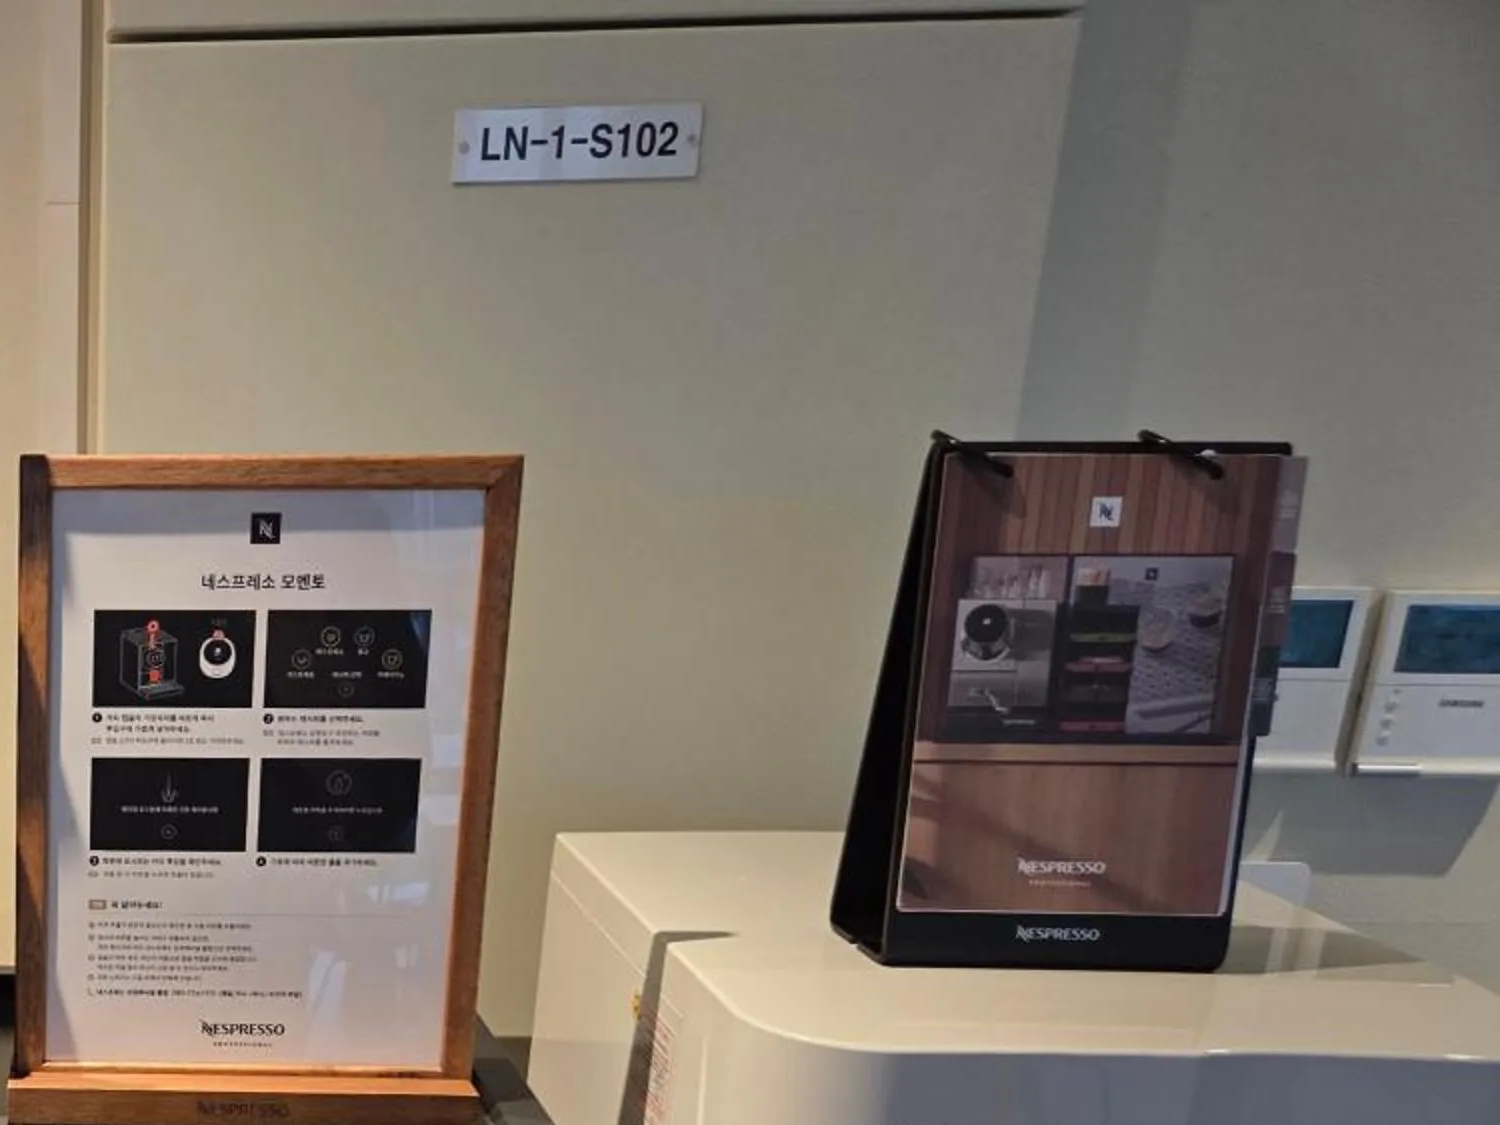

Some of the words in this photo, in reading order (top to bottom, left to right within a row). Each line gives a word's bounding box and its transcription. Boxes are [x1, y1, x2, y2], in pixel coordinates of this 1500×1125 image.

[480, 121, 679, 161] LN-1-S102
[201, 573, 276, 591] 네스프레소
[281, 573, 326, 591] 모멘토
[1017, 857, 1107, 876] NESPRESSO
[1016, 924, 1101, 942] NESPRESSO
[200, 1020, 286, 1037] NESPRESSO
